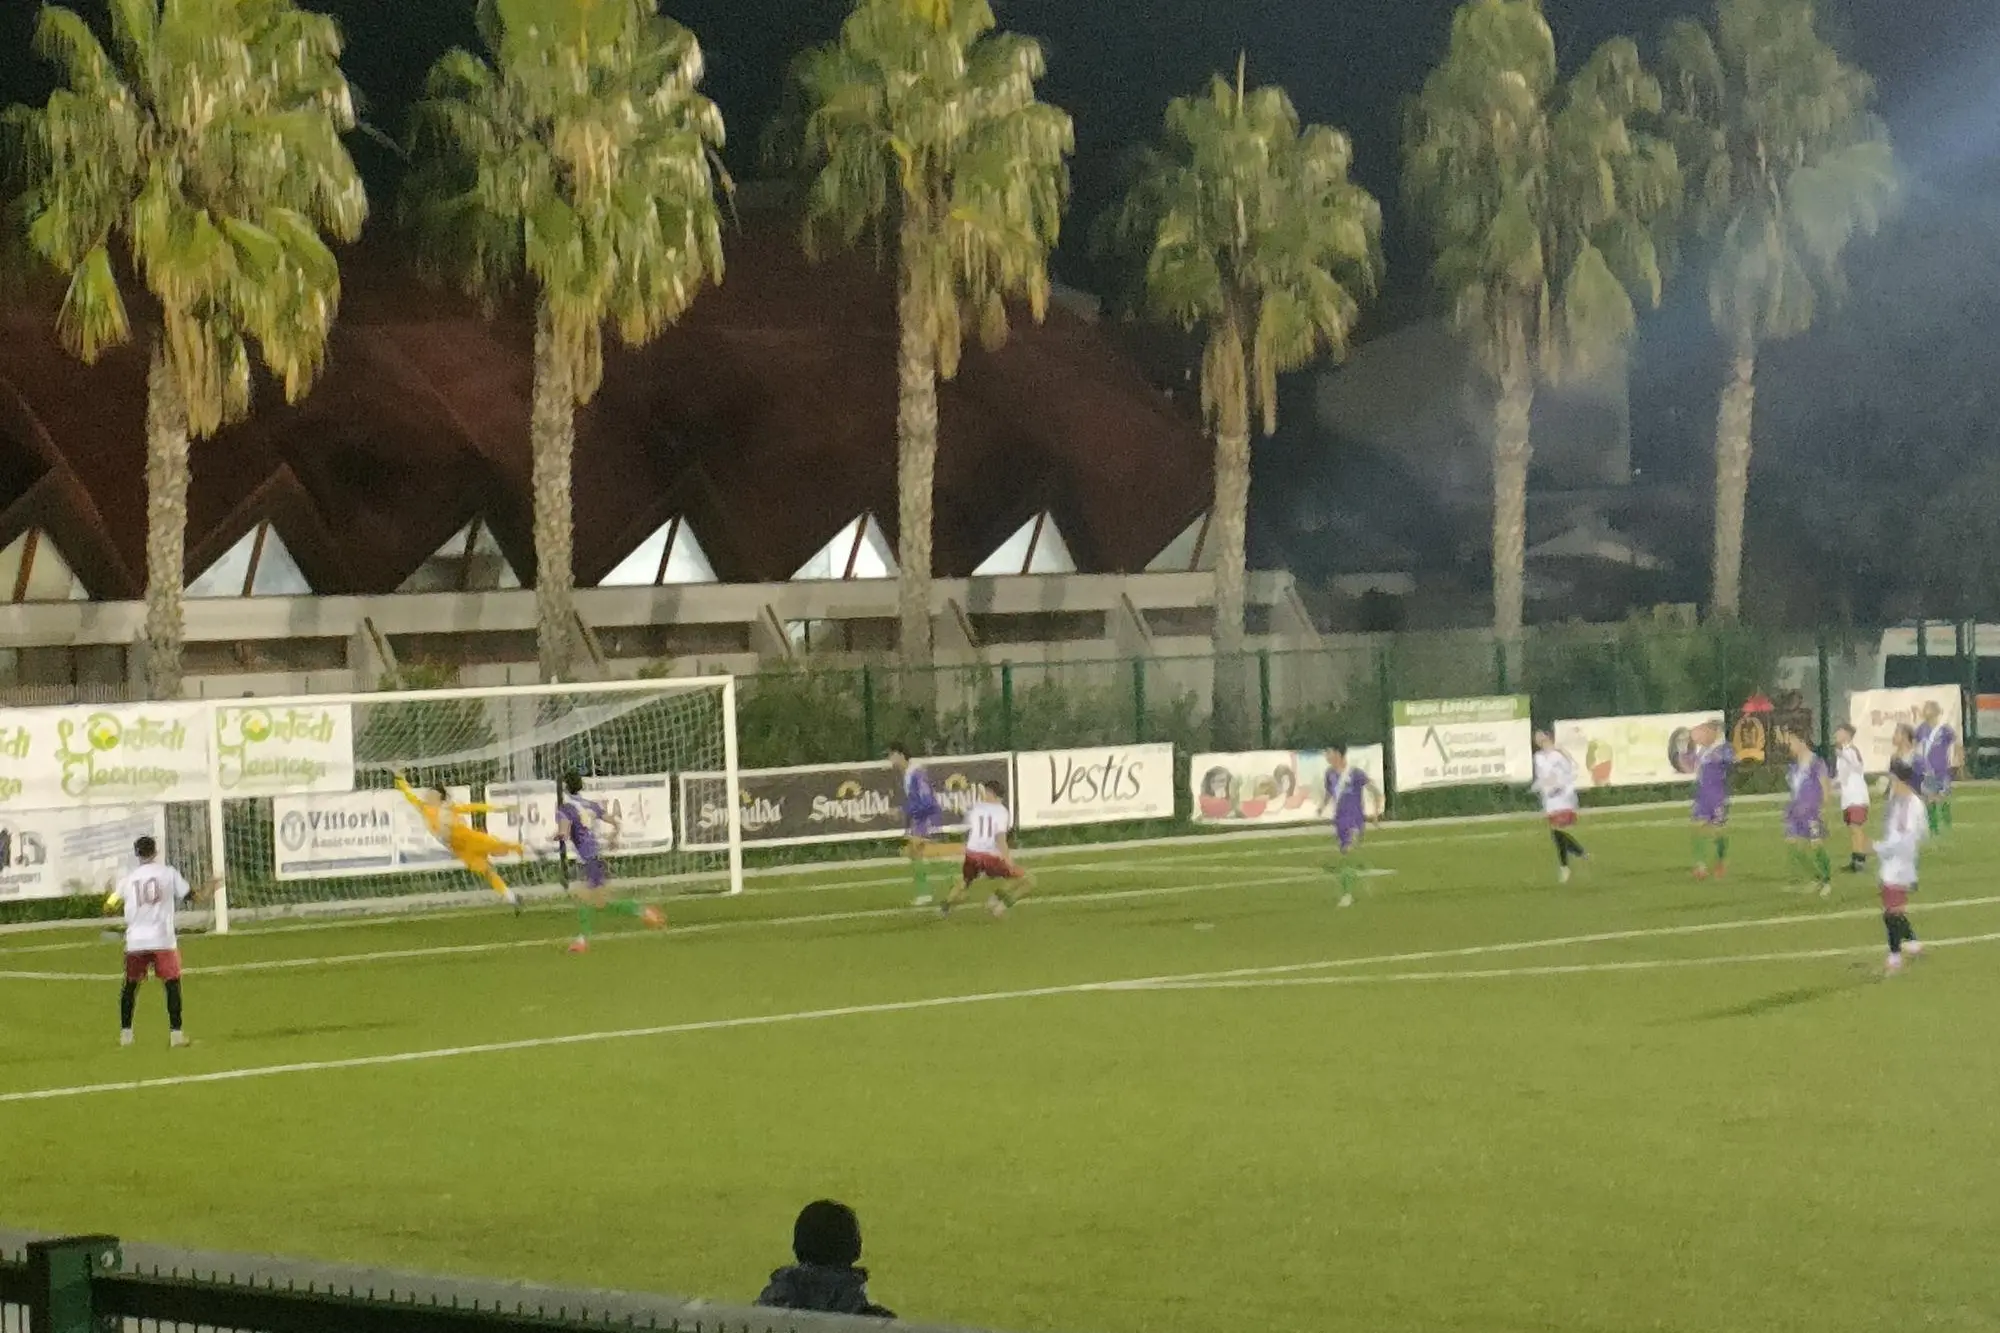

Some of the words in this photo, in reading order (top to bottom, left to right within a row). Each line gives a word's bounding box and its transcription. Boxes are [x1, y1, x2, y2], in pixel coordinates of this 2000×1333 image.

[1049, 753, 1143, 804] Vestis
[308, 807, 390, 830] Vittoria
[979, 814, 992, 838] 11
[133, 877, 163, 908] 10
